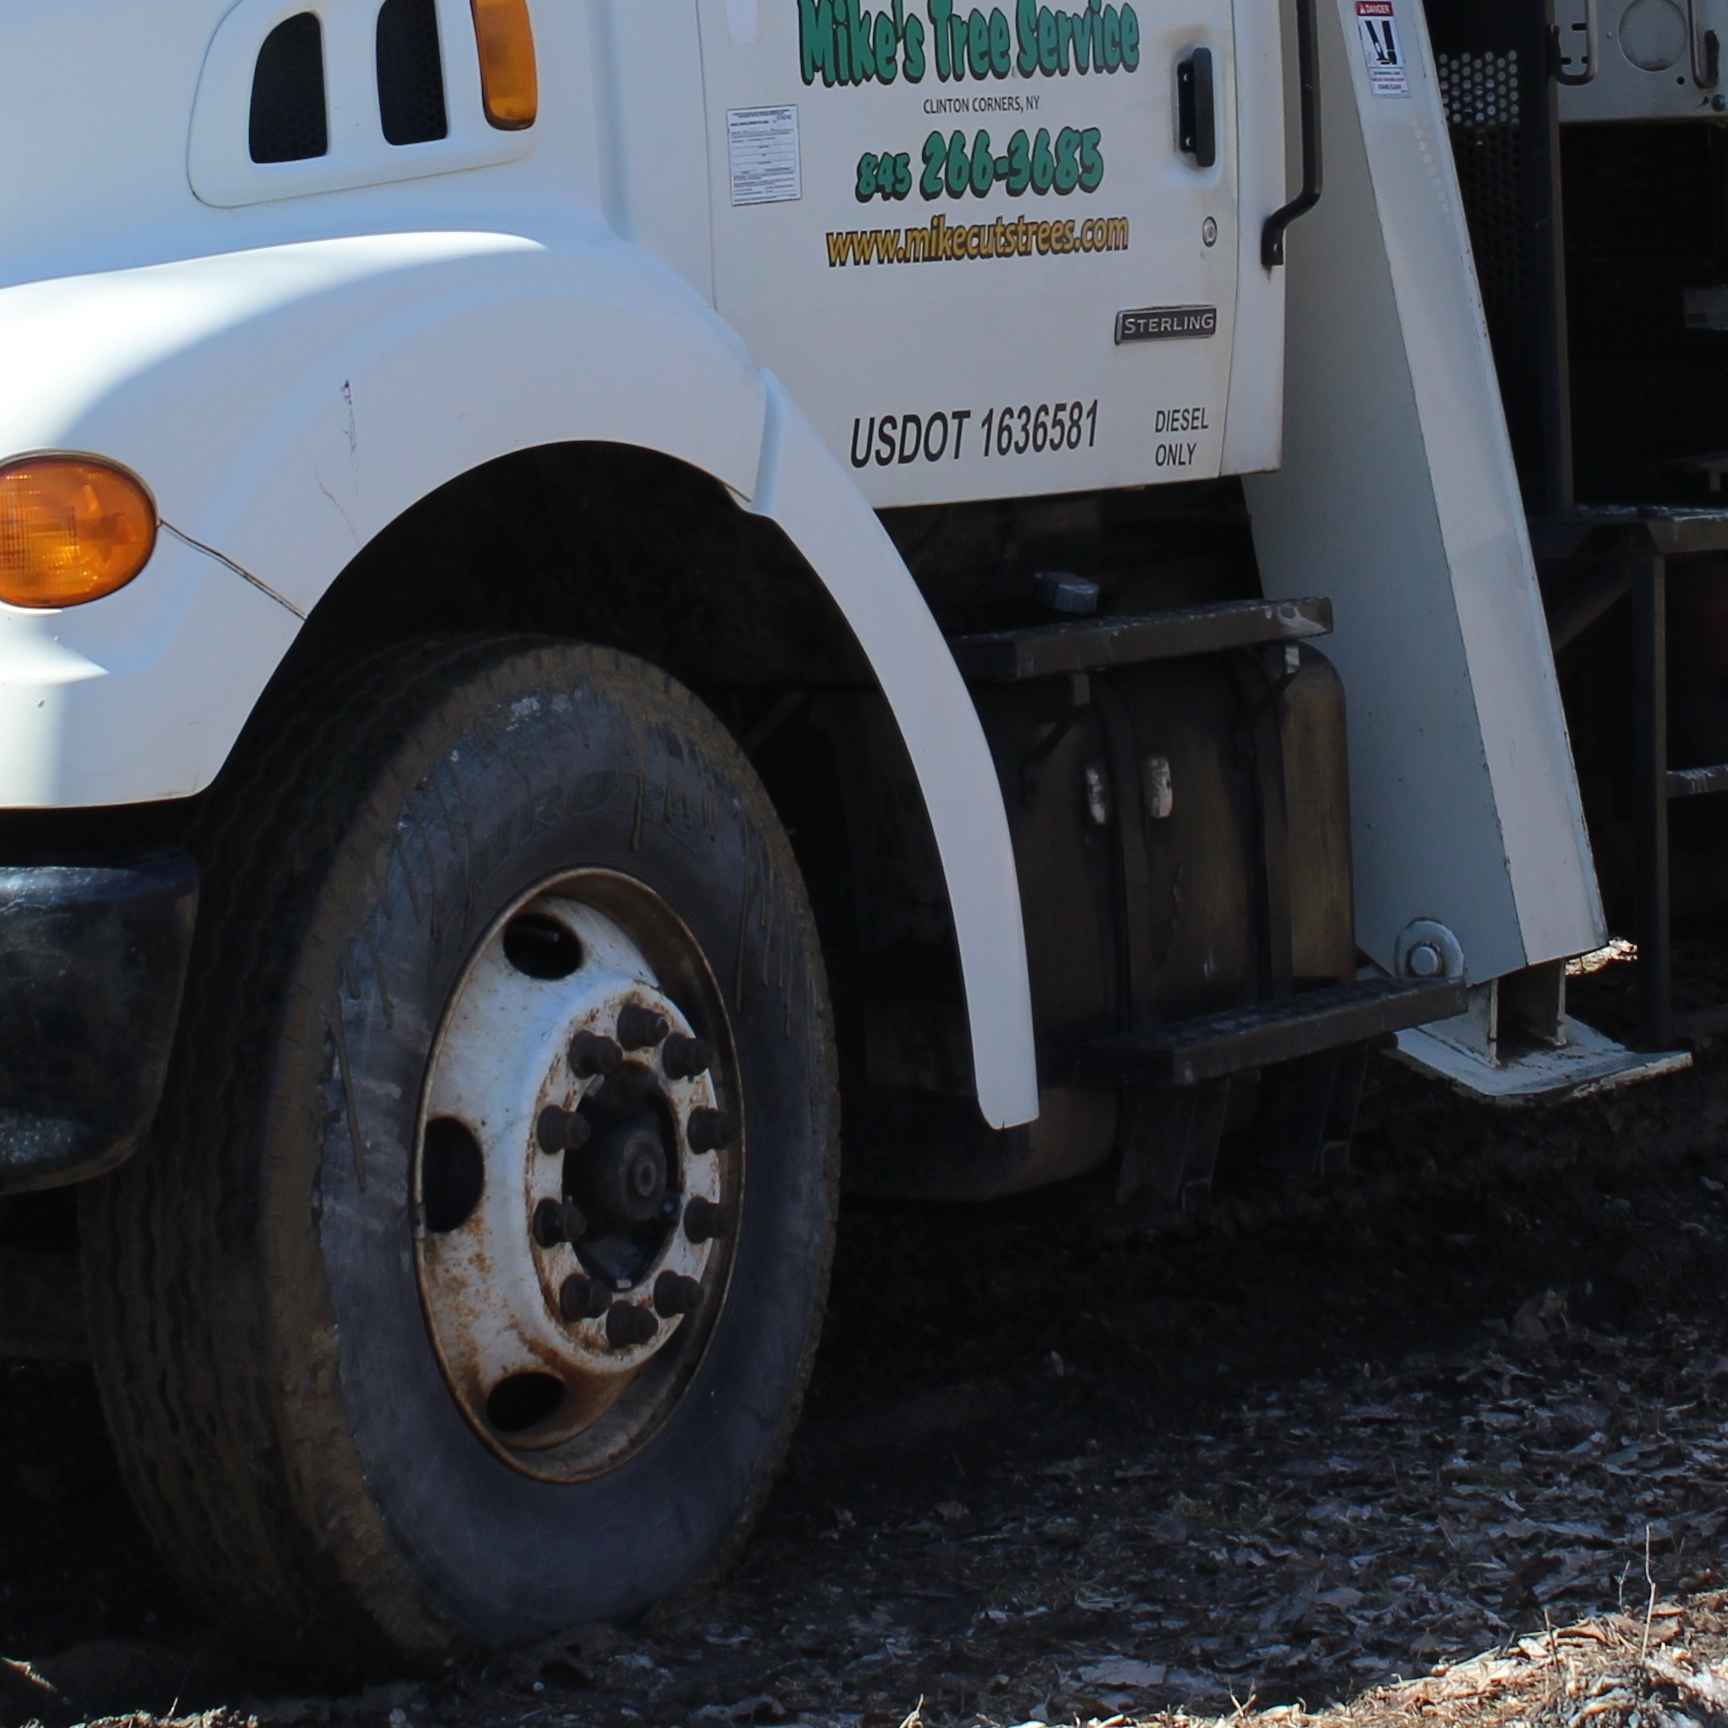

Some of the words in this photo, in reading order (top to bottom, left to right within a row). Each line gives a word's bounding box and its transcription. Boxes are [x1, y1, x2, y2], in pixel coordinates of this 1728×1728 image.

[923, 98, 970, 114] CLINTON
[972, 96, 1023, 113] CORNERS,
[1025, 95, 1040, 111] NY
[855, 152, 912, 203] 845
[920, 127, 1104, 201] 266-3685
[826, 214, 1129, 267] www.mikecutstrees.com
[1123, 314, 1215, 334] STERLING
[1155, 407, 1209, 433] DIESEL
[850, 409, 971, 468] USDOT
[980, 399, 1099, 457] 1636581
[1155, 443, 1198, 467] ONLY
